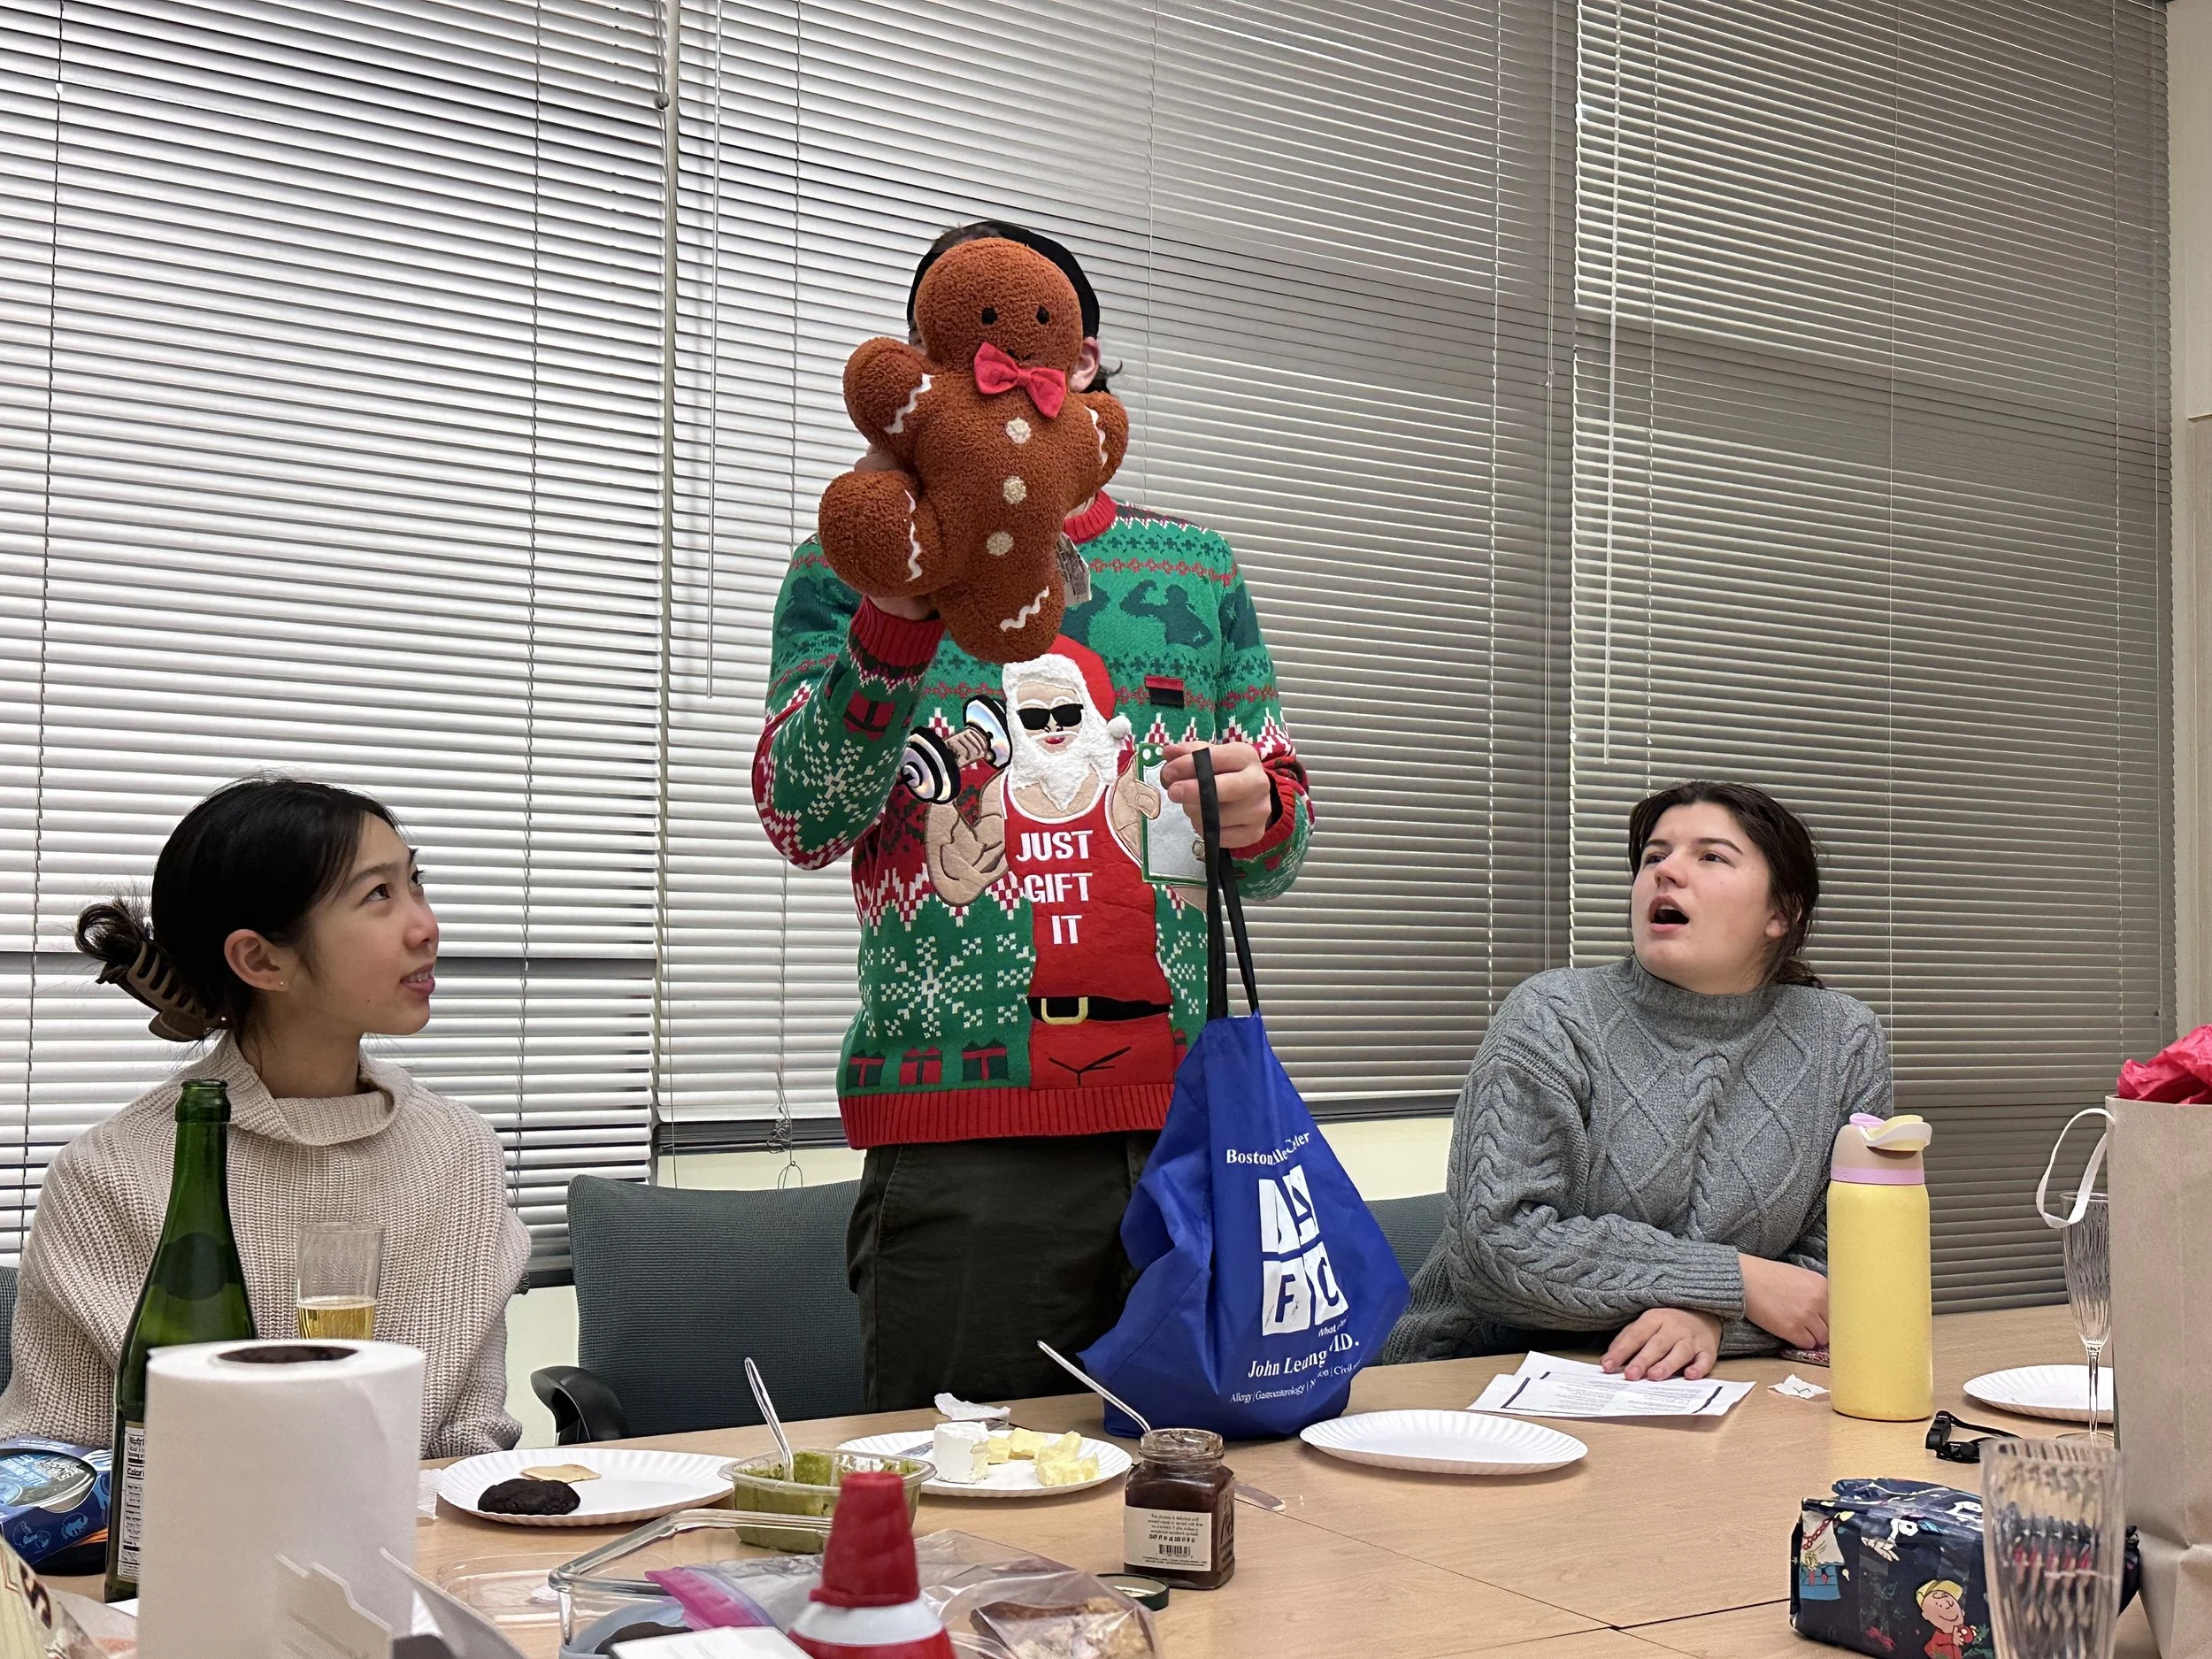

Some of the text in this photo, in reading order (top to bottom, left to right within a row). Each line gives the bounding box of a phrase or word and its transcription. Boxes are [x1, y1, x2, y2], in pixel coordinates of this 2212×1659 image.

[1015, 829, 1094, 862] JUST
[1023, 872, 1094, 904] GIFT
[1051, 914, 1083, 945] IT
[1226, 1148, 1274, 1165] Boston
[1248, 1360, 1279, 1379] John
[1283, 1350, 1327, 1375] Leung
